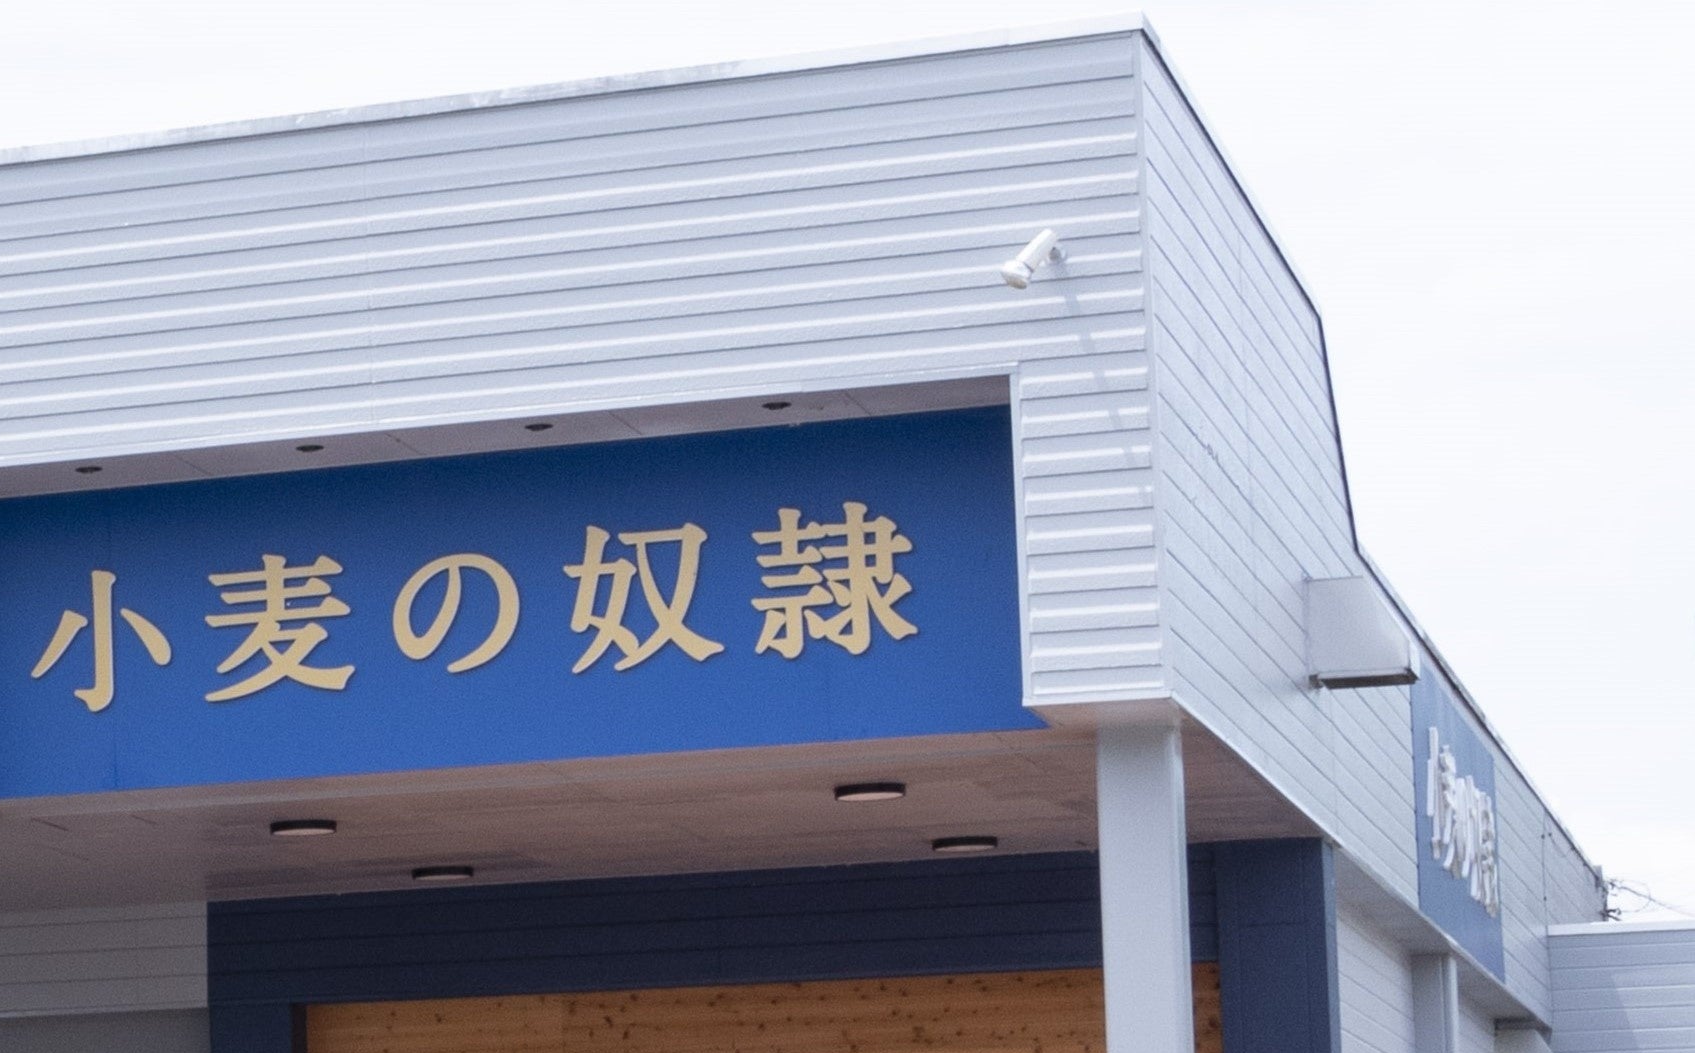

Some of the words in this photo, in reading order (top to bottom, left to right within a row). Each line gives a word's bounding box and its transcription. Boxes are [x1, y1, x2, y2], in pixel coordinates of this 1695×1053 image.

[31, 502, 918, 712] 小麦の奴隷
